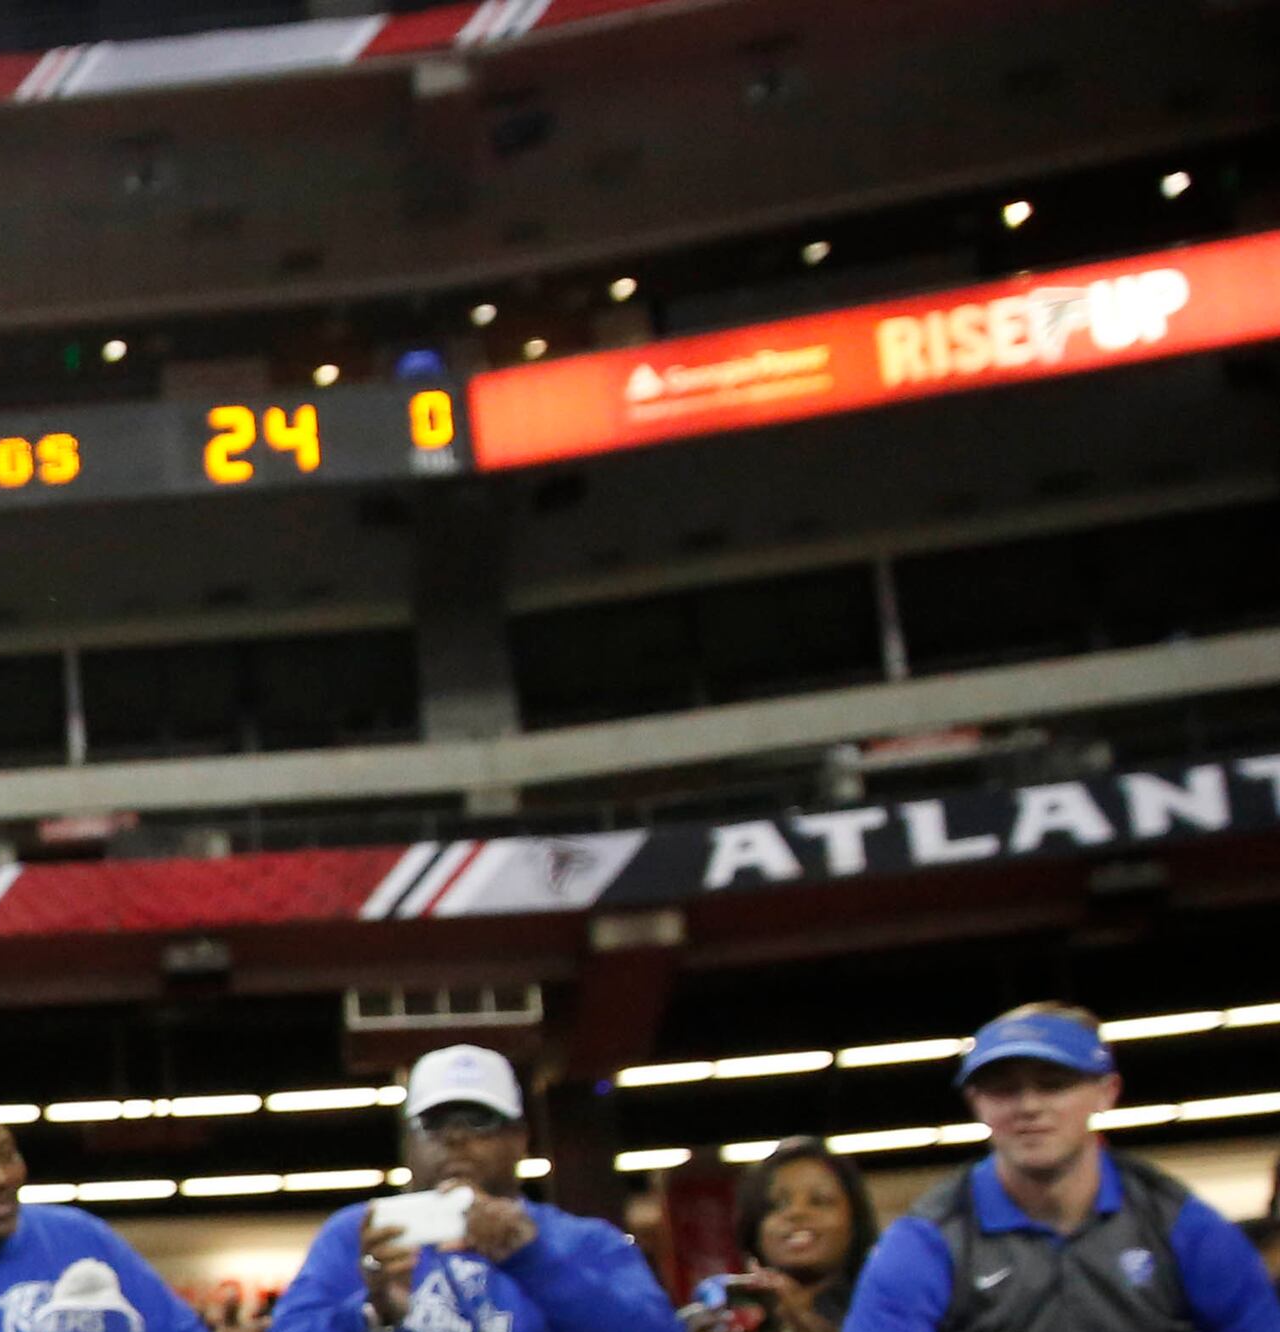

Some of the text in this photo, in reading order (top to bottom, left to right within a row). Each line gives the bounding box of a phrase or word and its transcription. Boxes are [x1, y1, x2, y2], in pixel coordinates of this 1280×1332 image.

[876, 268, 1190, 387] RISE UP
[203, 404, 321, 484] 24
[409, 390, 454, 449] 0
